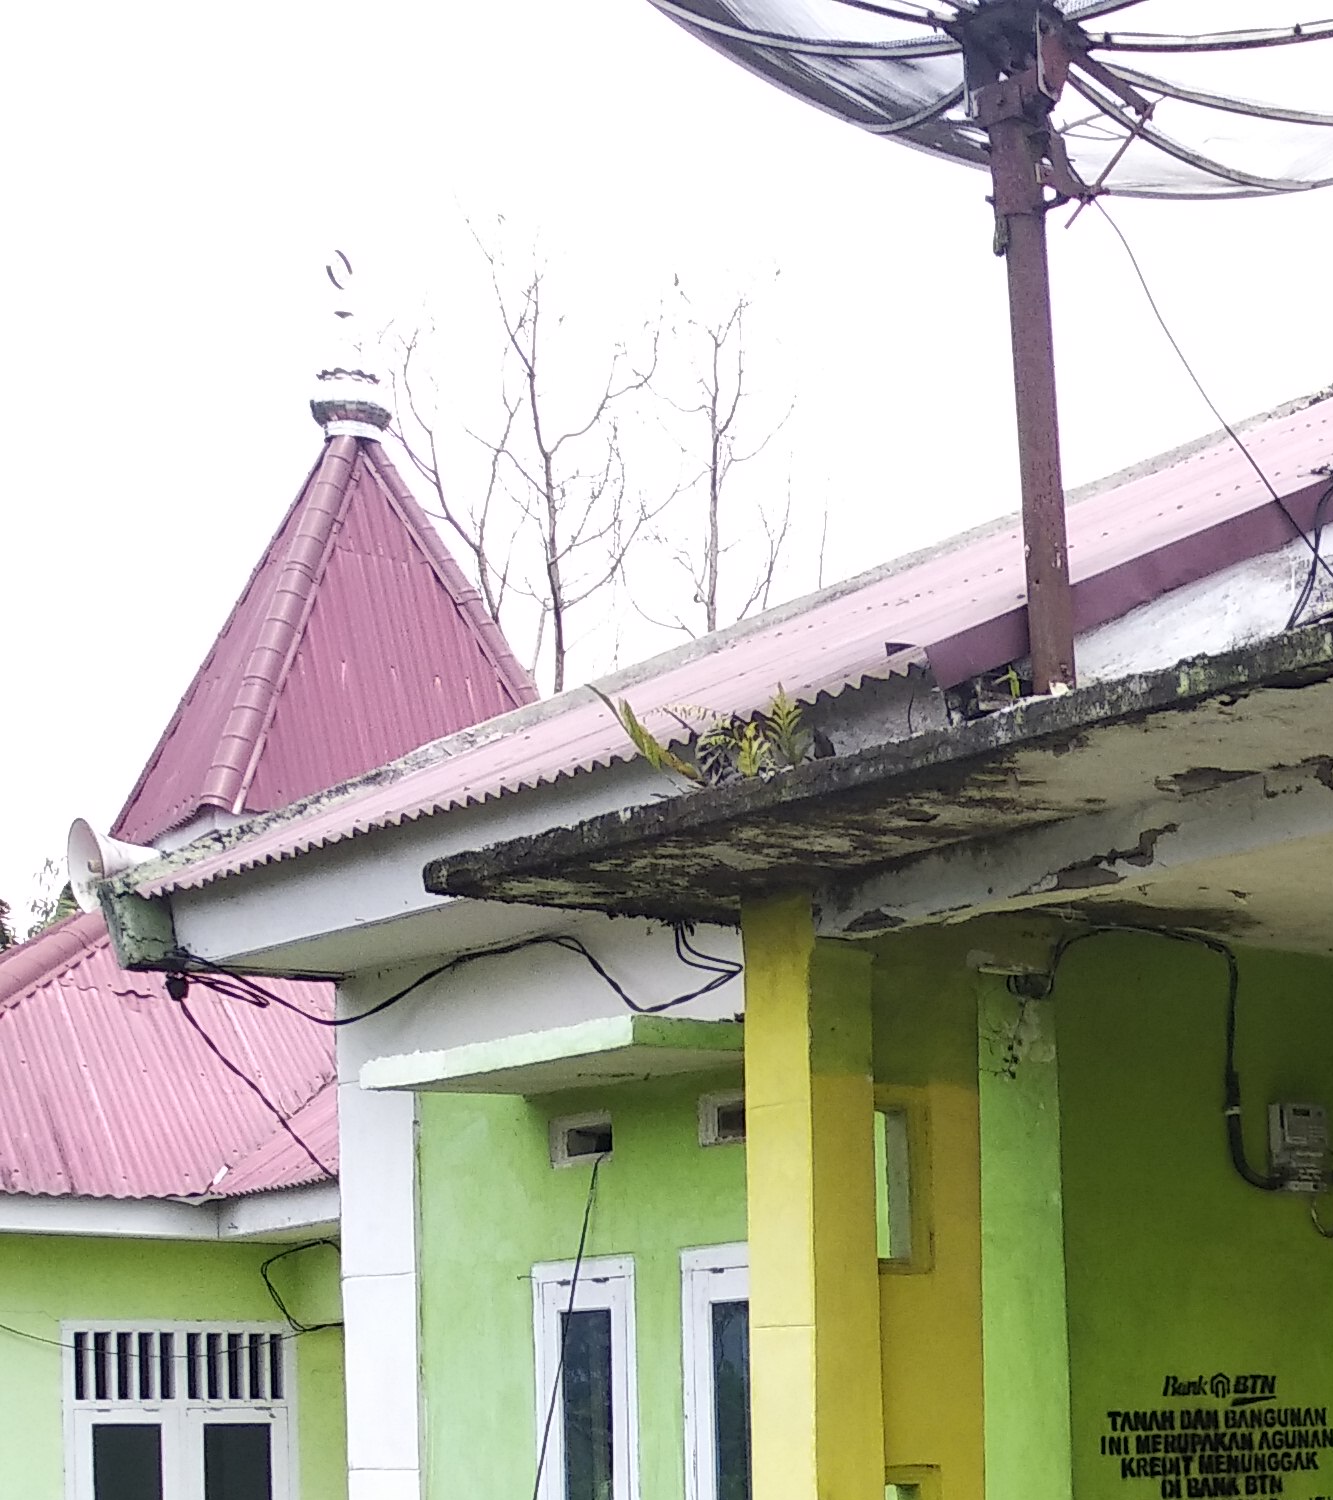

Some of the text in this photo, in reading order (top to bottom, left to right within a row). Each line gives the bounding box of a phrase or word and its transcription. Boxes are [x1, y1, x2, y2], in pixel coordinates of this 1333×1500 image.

[1163, 1375, 1276, 1396] Bank BTN
[1107, 1407, 1327, 1431] TANAH DAN BANGUNAN
[1101, 1435, 1129, 1455] INI
[1136, 1432, 1253, 1454] MERUPAKAN
[1121, 1451, 1318, 1479] KREDIT MENUNGGAK
[1161, 1476, 1283, 1499] DI BANK BTN
